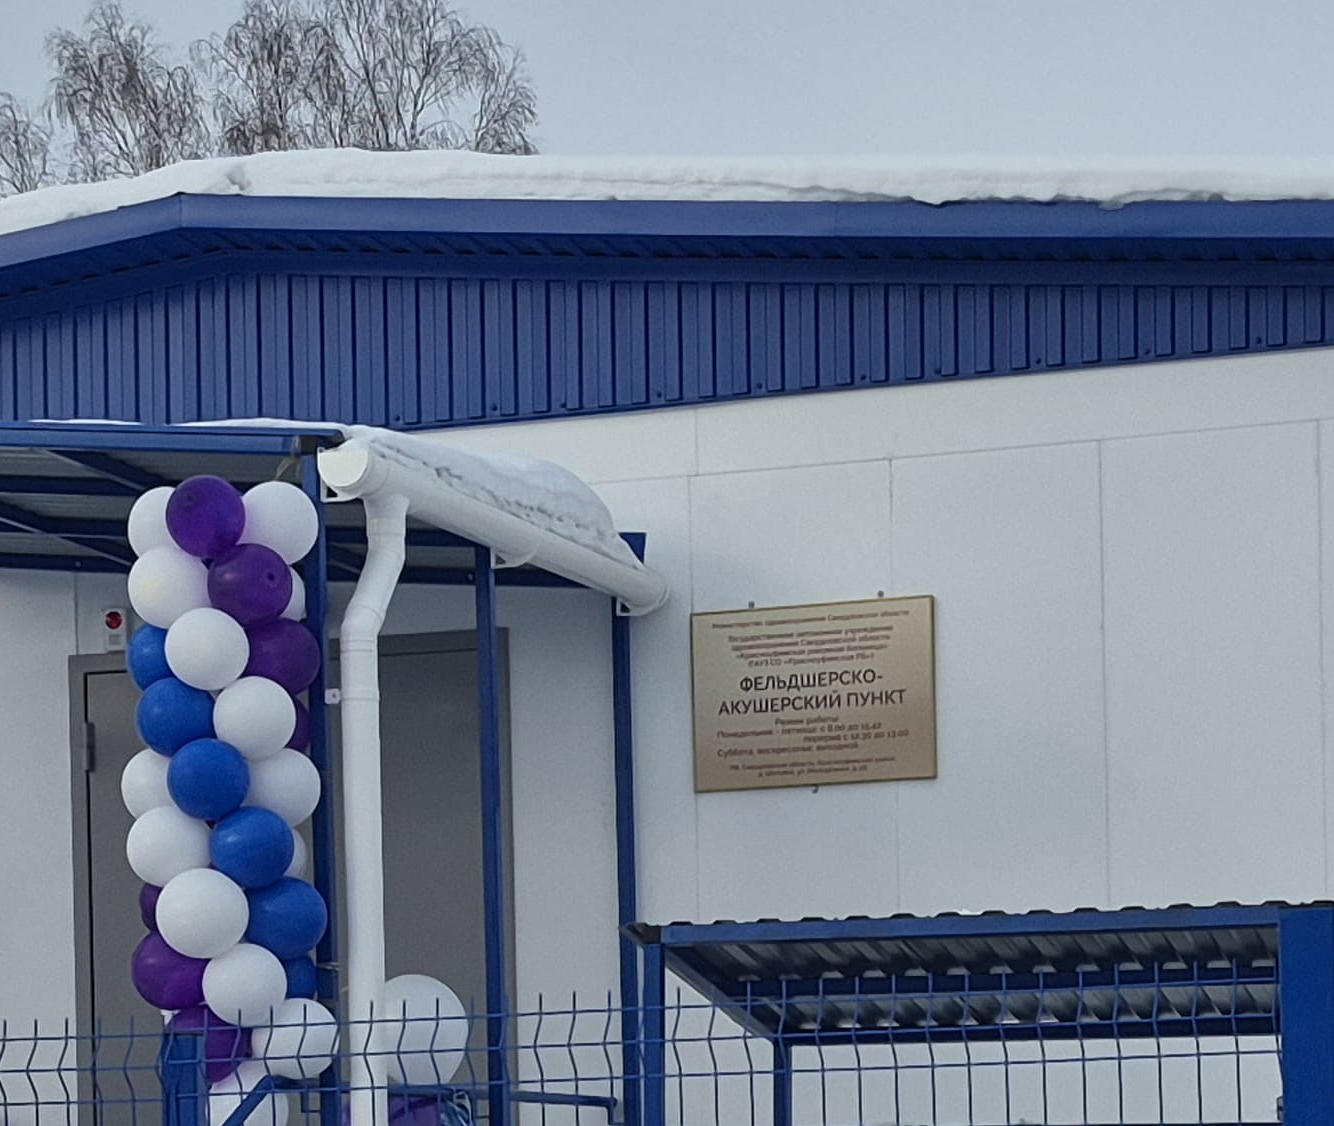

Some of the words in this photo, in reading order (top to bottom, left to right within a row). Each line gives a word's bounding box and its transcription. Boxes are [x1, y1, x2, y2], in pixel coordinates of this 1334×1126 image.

[739, 668, 883, 692] ФЕЛЬДШЕРСКО-
[718, 690, 842, 716] АКУШЕРСКИЙ
[847, 688, 907, 708] ПУНКТ
